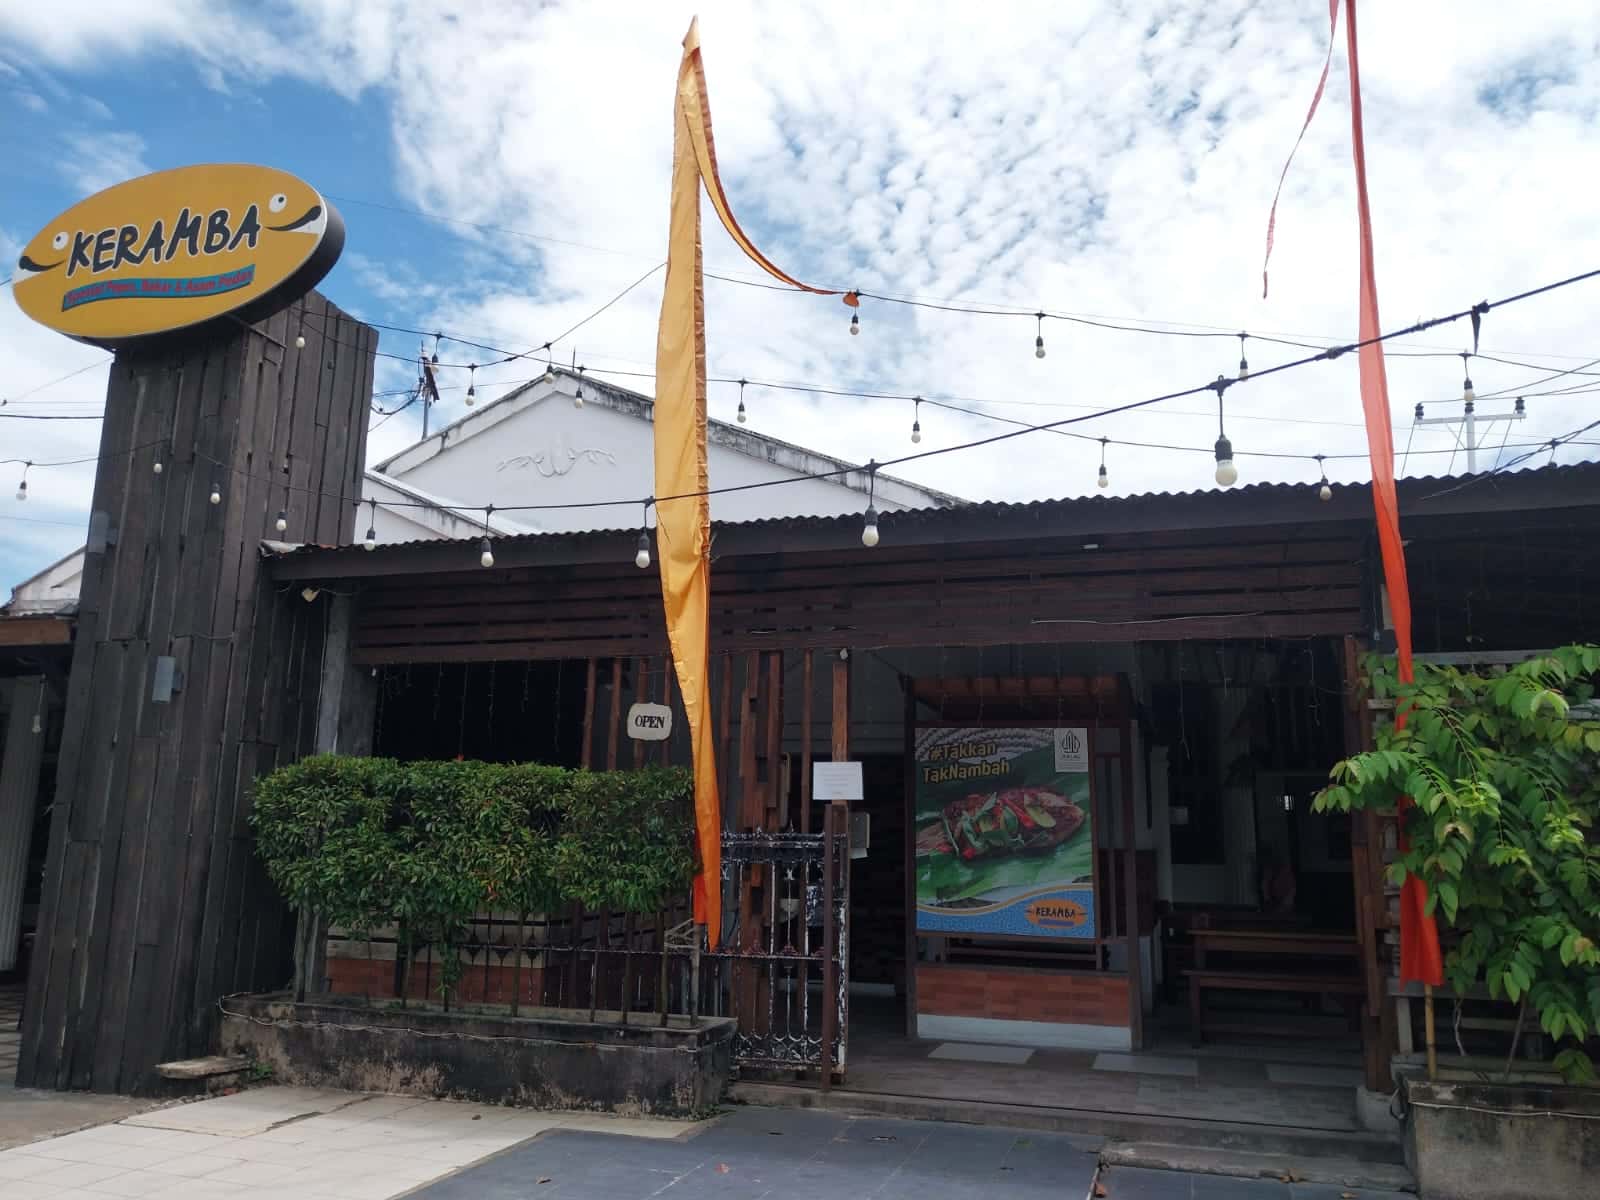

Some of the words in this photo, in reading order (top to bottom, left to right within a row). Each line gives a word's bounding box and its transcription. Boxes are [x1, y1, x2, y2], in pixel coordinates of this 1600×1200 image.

[67, 204, 261, 277] KERAMBA
[634, 714, 665, 729] OPEN
[928, 742, 997, 761] #Takkan
[922, 760, 1010, 784] TakNambah
[1035, 906, 1076, 918] KERAMBA
